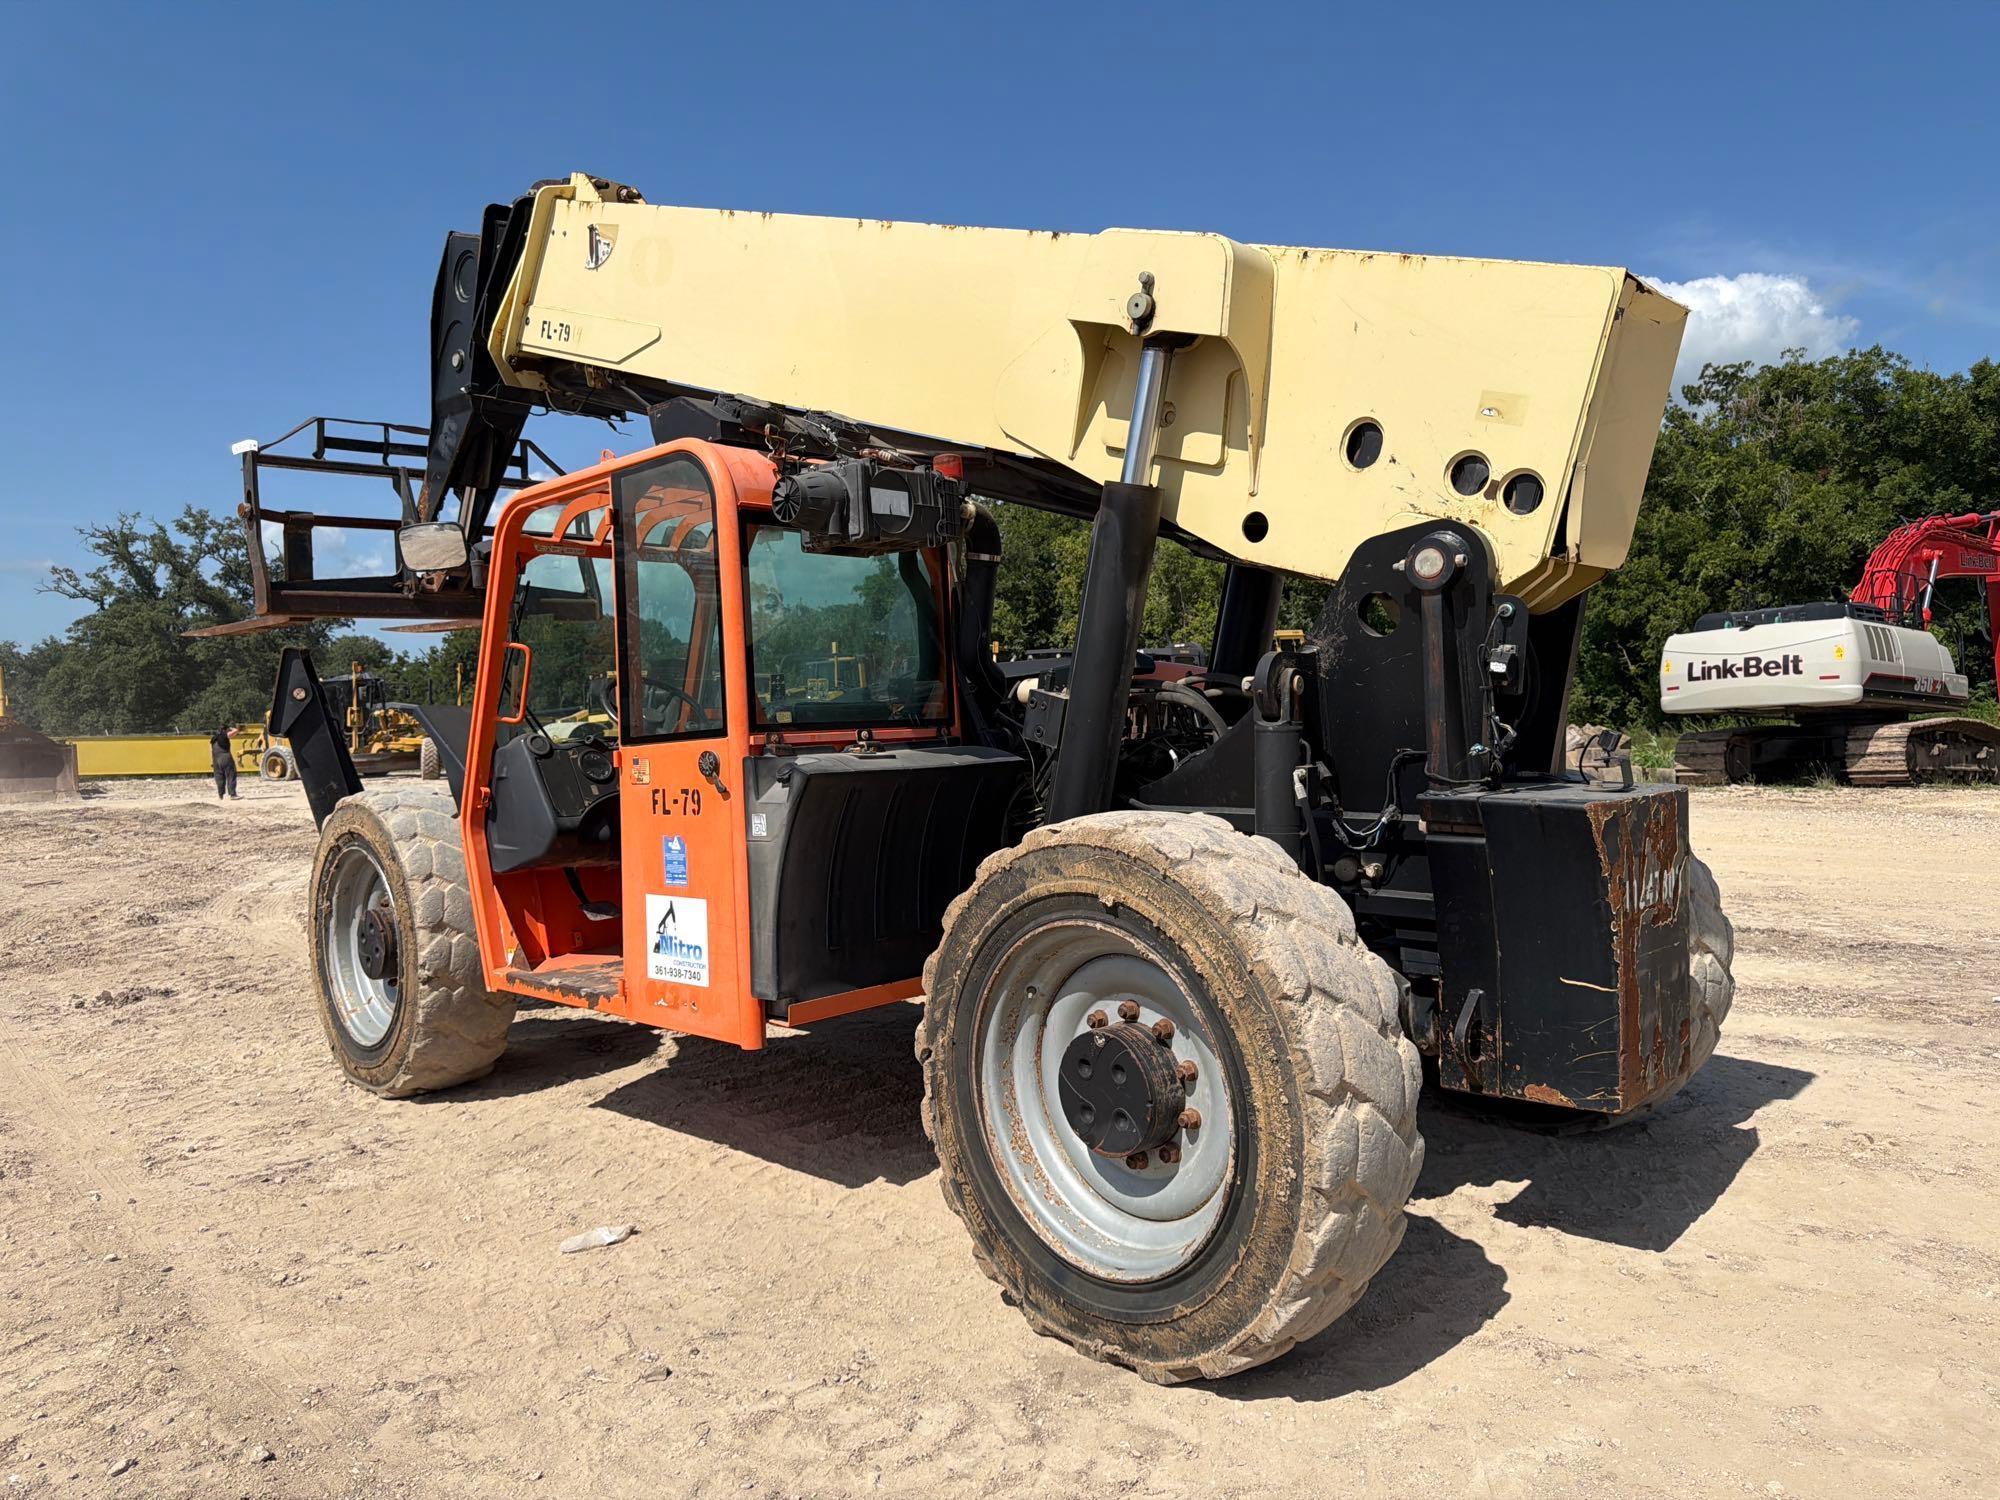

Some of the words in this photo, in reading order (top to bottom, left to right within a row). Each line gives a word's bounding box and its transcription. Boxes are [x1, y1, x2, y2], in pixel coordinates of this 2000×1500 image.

[540, 320, 571, 342] FL-79
[1687, 654, 1803, 682] Link-Belt
[652, 788, 702, 816] FL-79
[659, 935, 703, 961] Nitro
[654, 965, 702, 982] 361-938-7340
[673, 959, 707, 970] CONSTRUCTION
